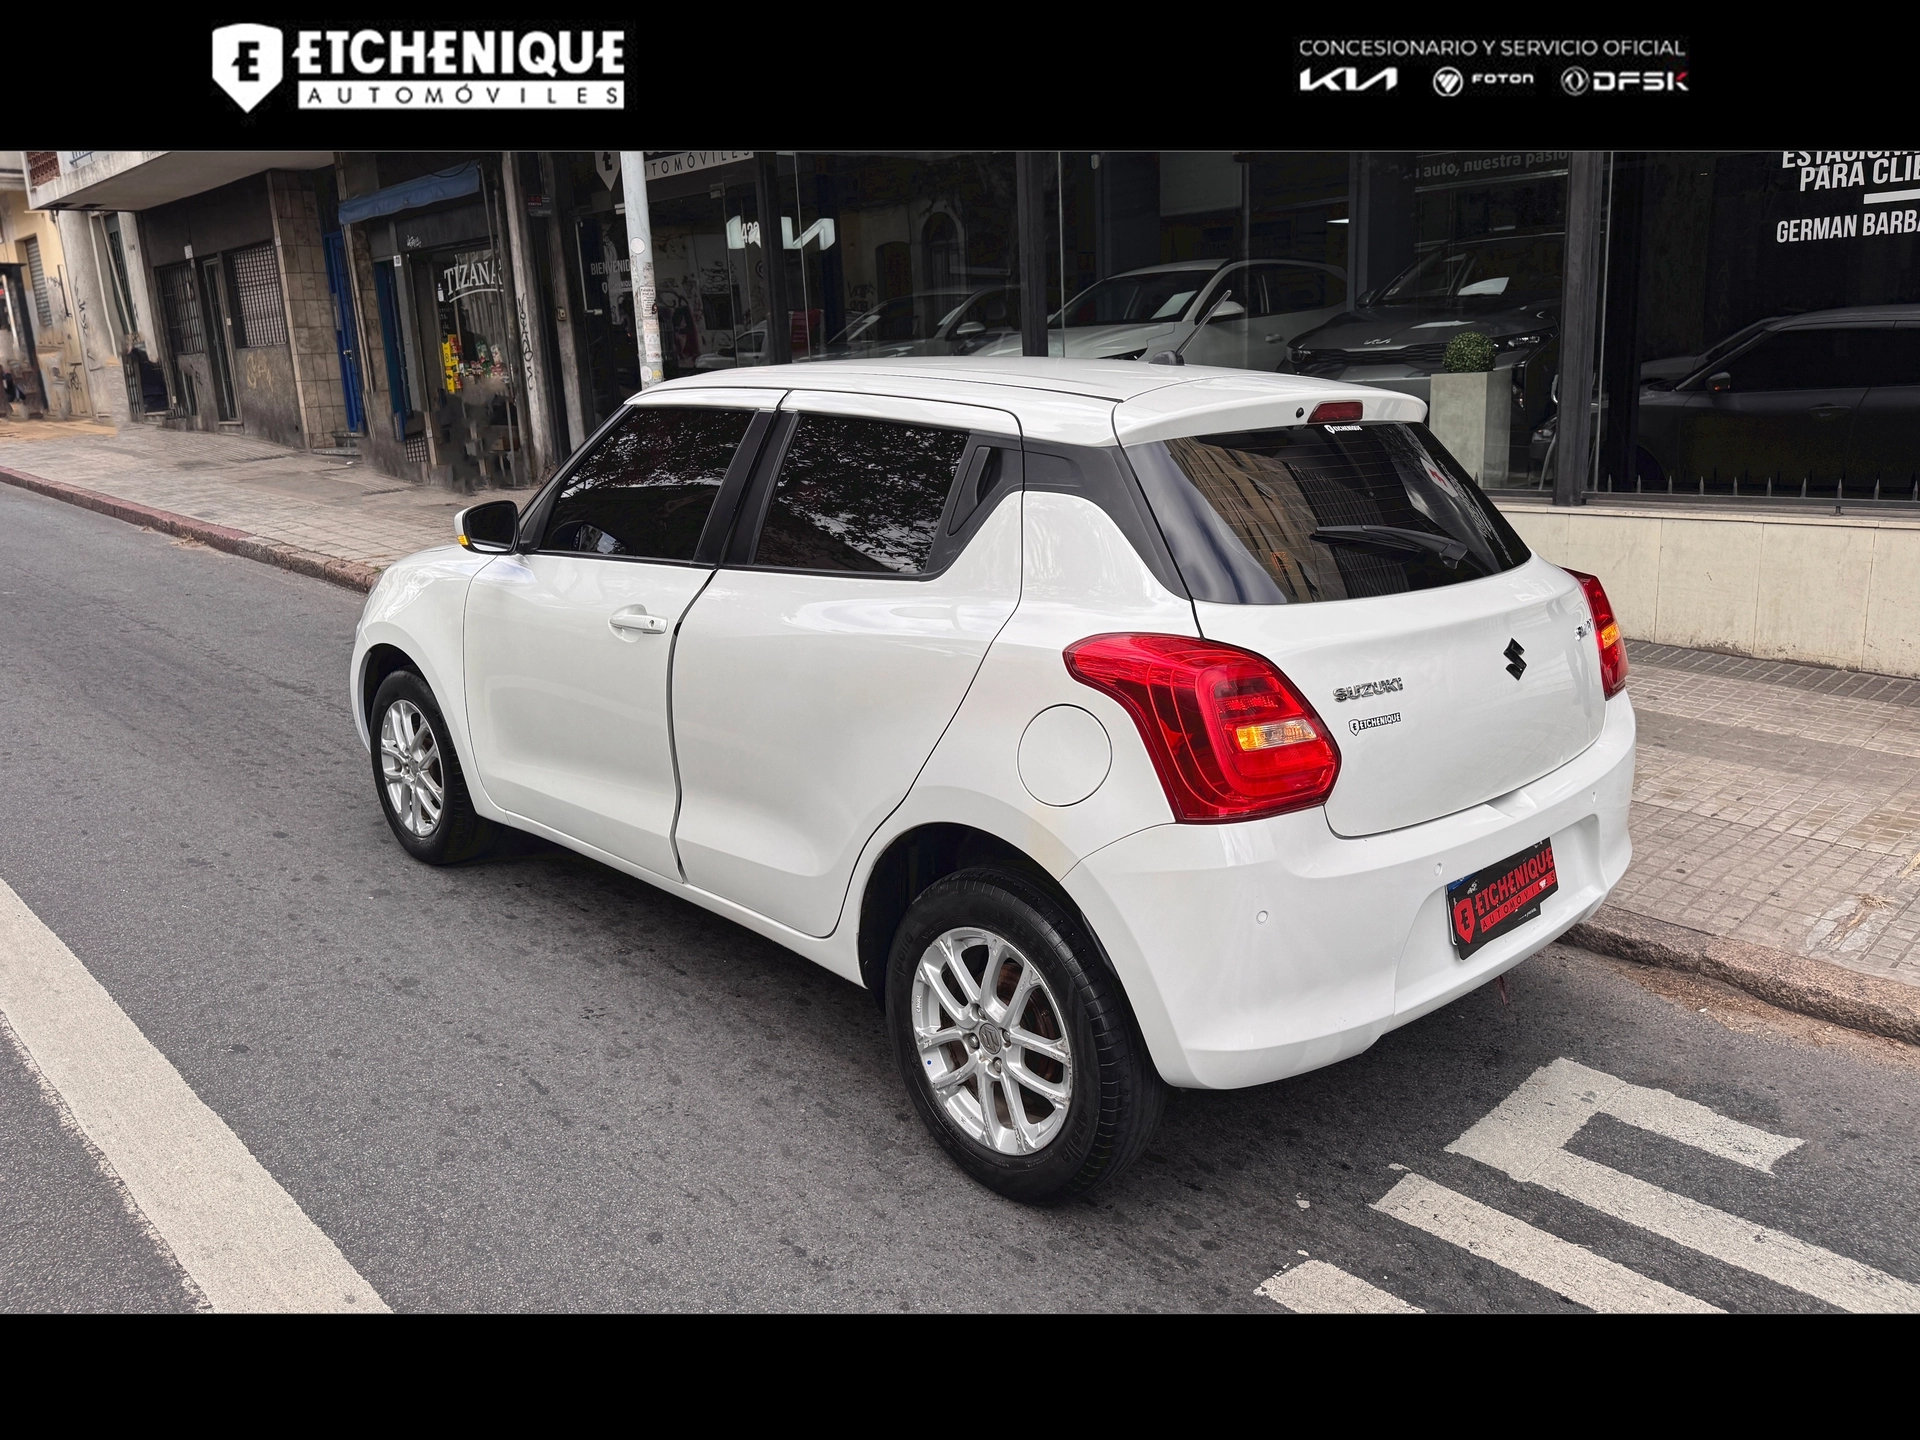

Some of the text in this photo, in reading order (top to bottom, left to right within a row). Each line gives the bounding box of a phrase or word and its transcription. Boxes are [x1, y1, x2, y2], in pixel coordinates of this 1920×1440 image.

[1463, 154, 1521, 173] nuestra
[1799, 161, 1865, 192] PARA
[1776, 209, 1920, 243] GERMAN BARB
[590, 258, 631, 275] BIENVENID
[1332, 677, 1404, 703] SUZUKI
[1359, 712, 1401, 730] ETCHENIQUE
[1475, 846, 1554, 916] ETCHENIQUE
